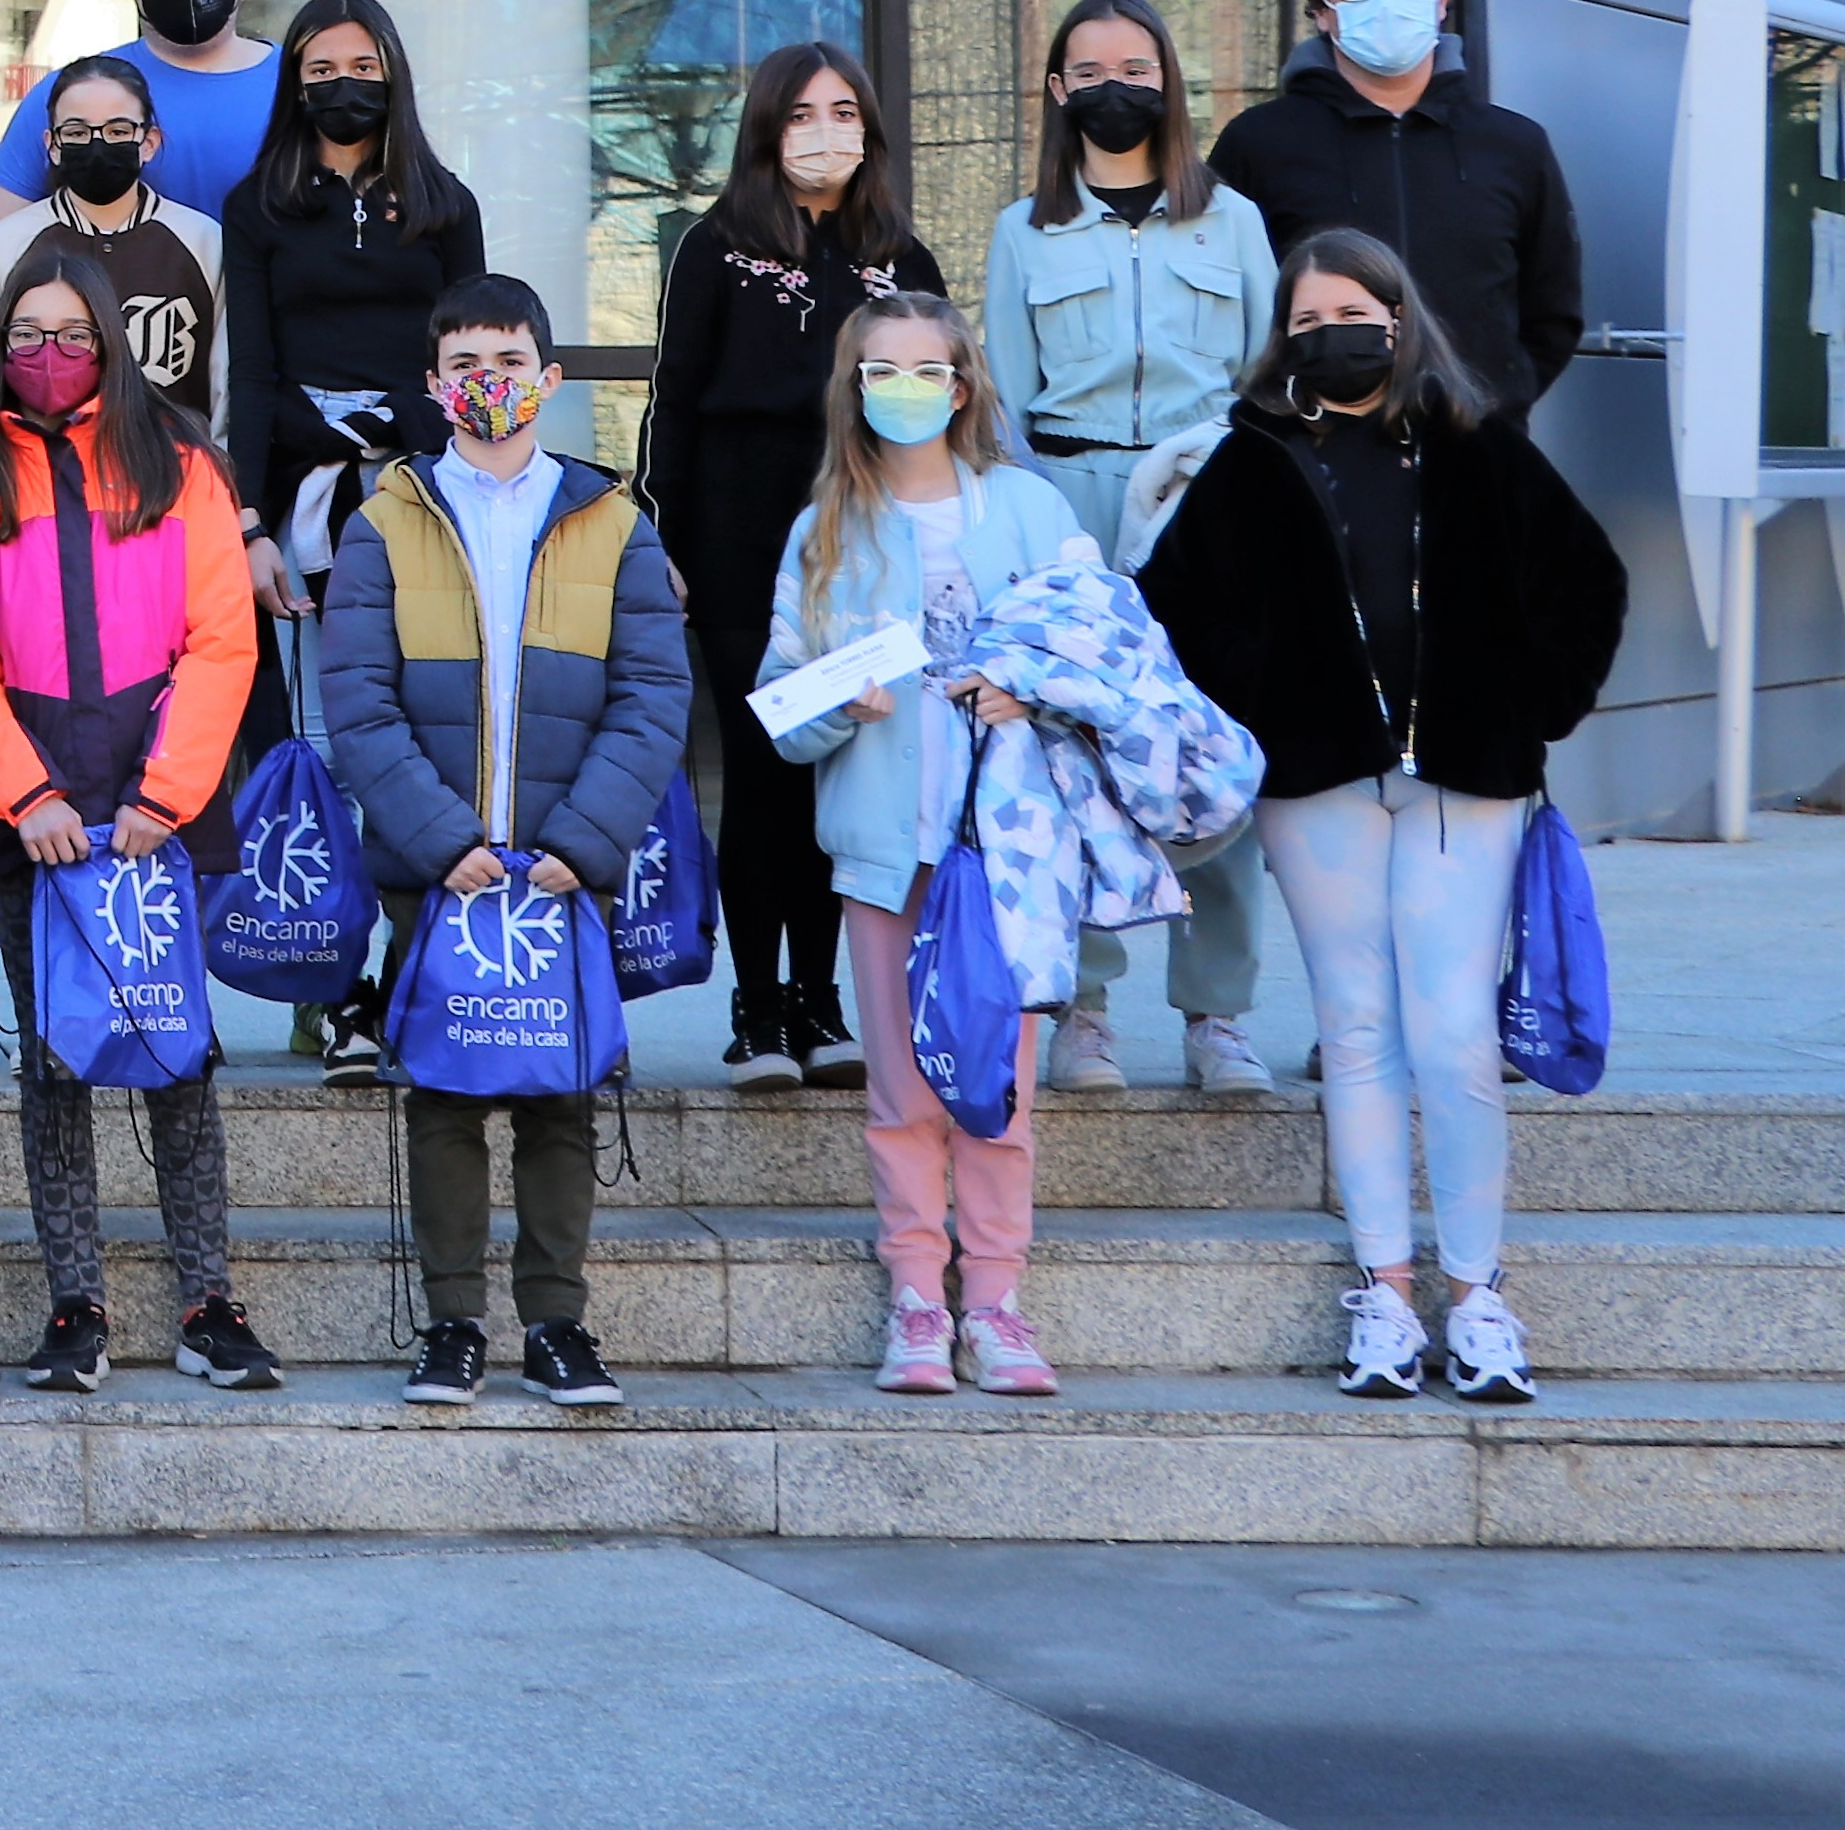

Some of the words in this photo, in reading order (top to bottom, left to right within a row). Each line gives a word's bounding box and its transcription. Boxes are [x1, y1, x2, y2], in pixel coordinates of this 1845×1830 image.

[226, 912, 339, 948] encamp
[221, 938, 237, 954] el
[238, 944, 265, 960] pas
[267, 947, 288, 963] de
[291, 946, 304, 963] la
[306, 949, 339, 963] casa
[158, 1016, 188, 1032] casa
[447, 995, 568, 1031] encamp
[447, 1021, 461, 1040] el
[462, 1028, 492, 1048] pas
[494, 1026, 517, 1046] de
[520, 1026, 533, 1046] la
[534, 1031, 568, 1047] casa
